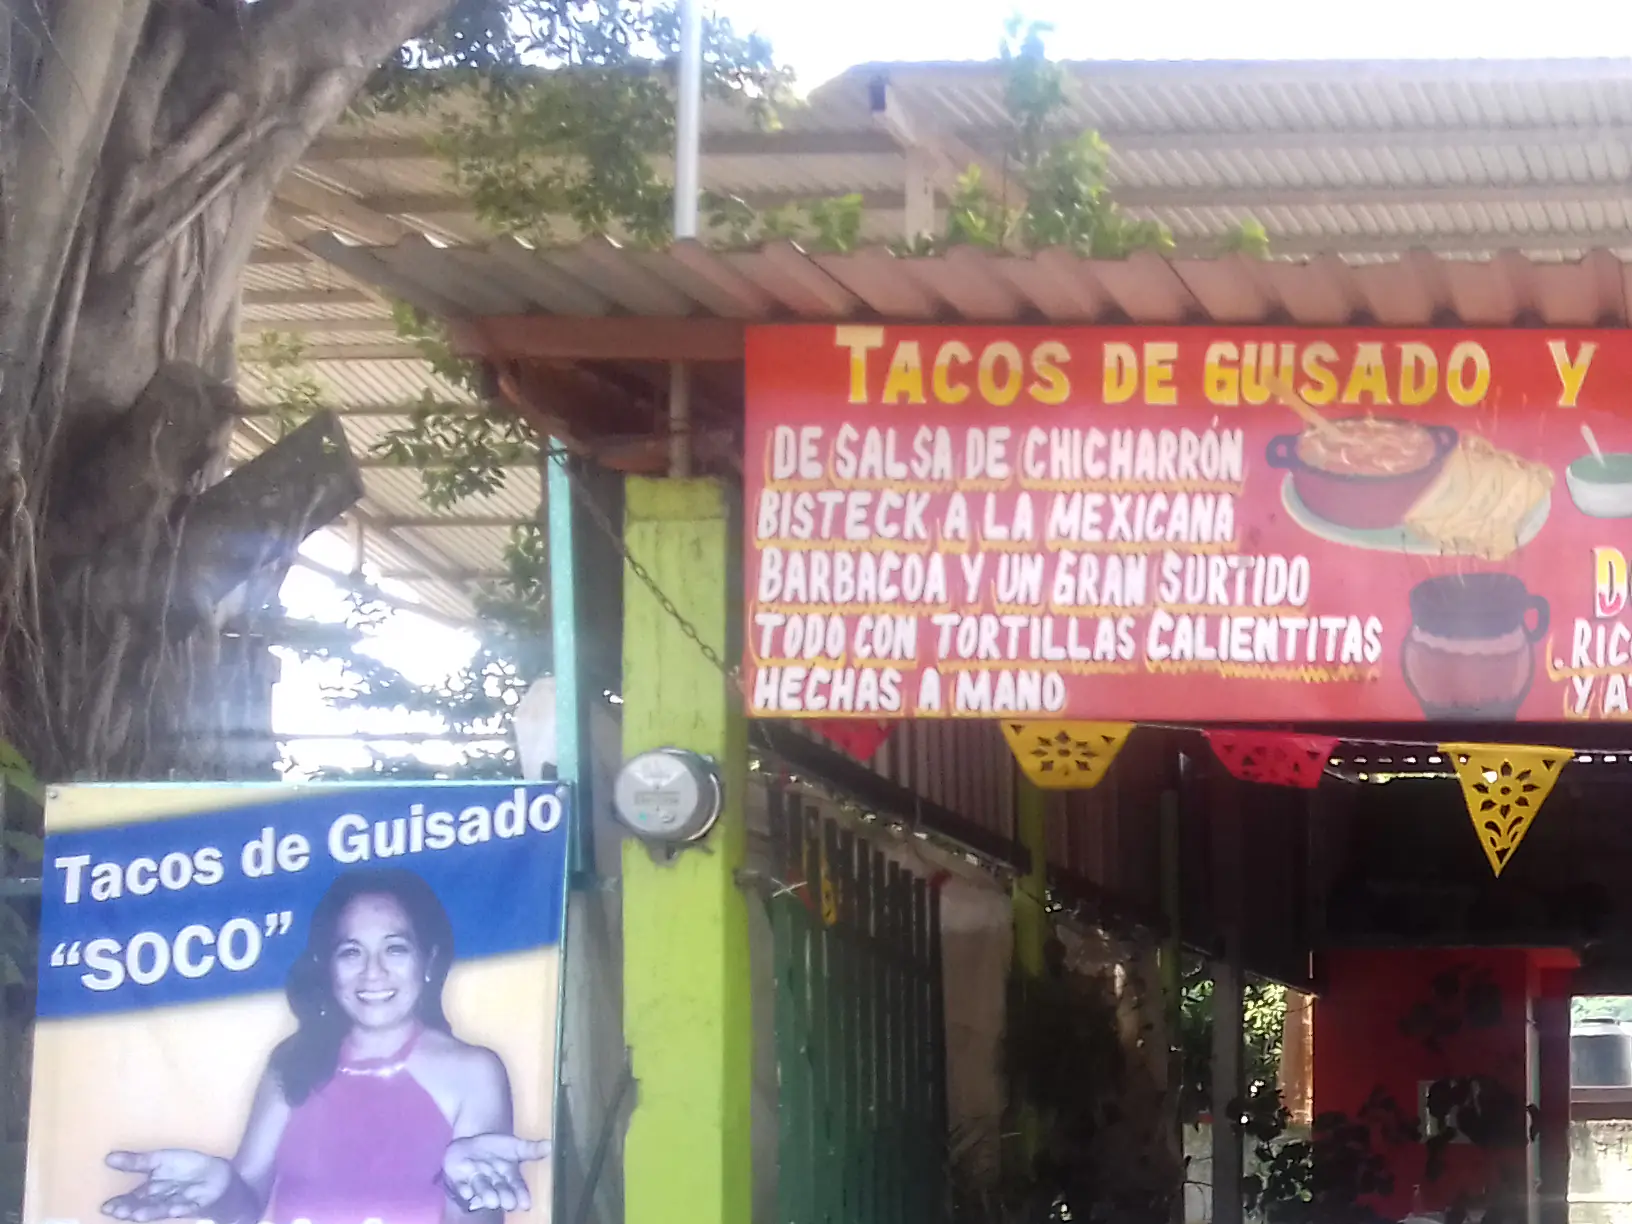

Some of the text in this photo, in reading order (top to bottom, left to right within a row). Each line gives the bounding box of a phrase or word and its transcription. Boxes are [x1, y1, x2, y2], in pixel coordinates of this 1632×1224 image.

[836, 326, 1071, 404] TACOS
[1105, 343, 1178, 405] DE
[1205, 341, 1491, 405] GUISADO
[1549, 341, 1597, 406] Y
[774, 416, 1243, 481] DE SALSA DE CHICHARRÓN
[756, 492, 1234, 541] BISTECK A LA MEXICANA
[757, 554, 1310, 606] BARBACOA Y UN GRAN SURTIDO
[753, 614, 1383, 663] TODO CON TORTILLAS CALIENTITAS
[752, 668, 1067, 713] HECHAS A MANO
[1574, 674, 1593, 715] Y
[54, 787, 563, 904] Tacos de Guisado
[49, 911, 293, 992] “SOCO”
